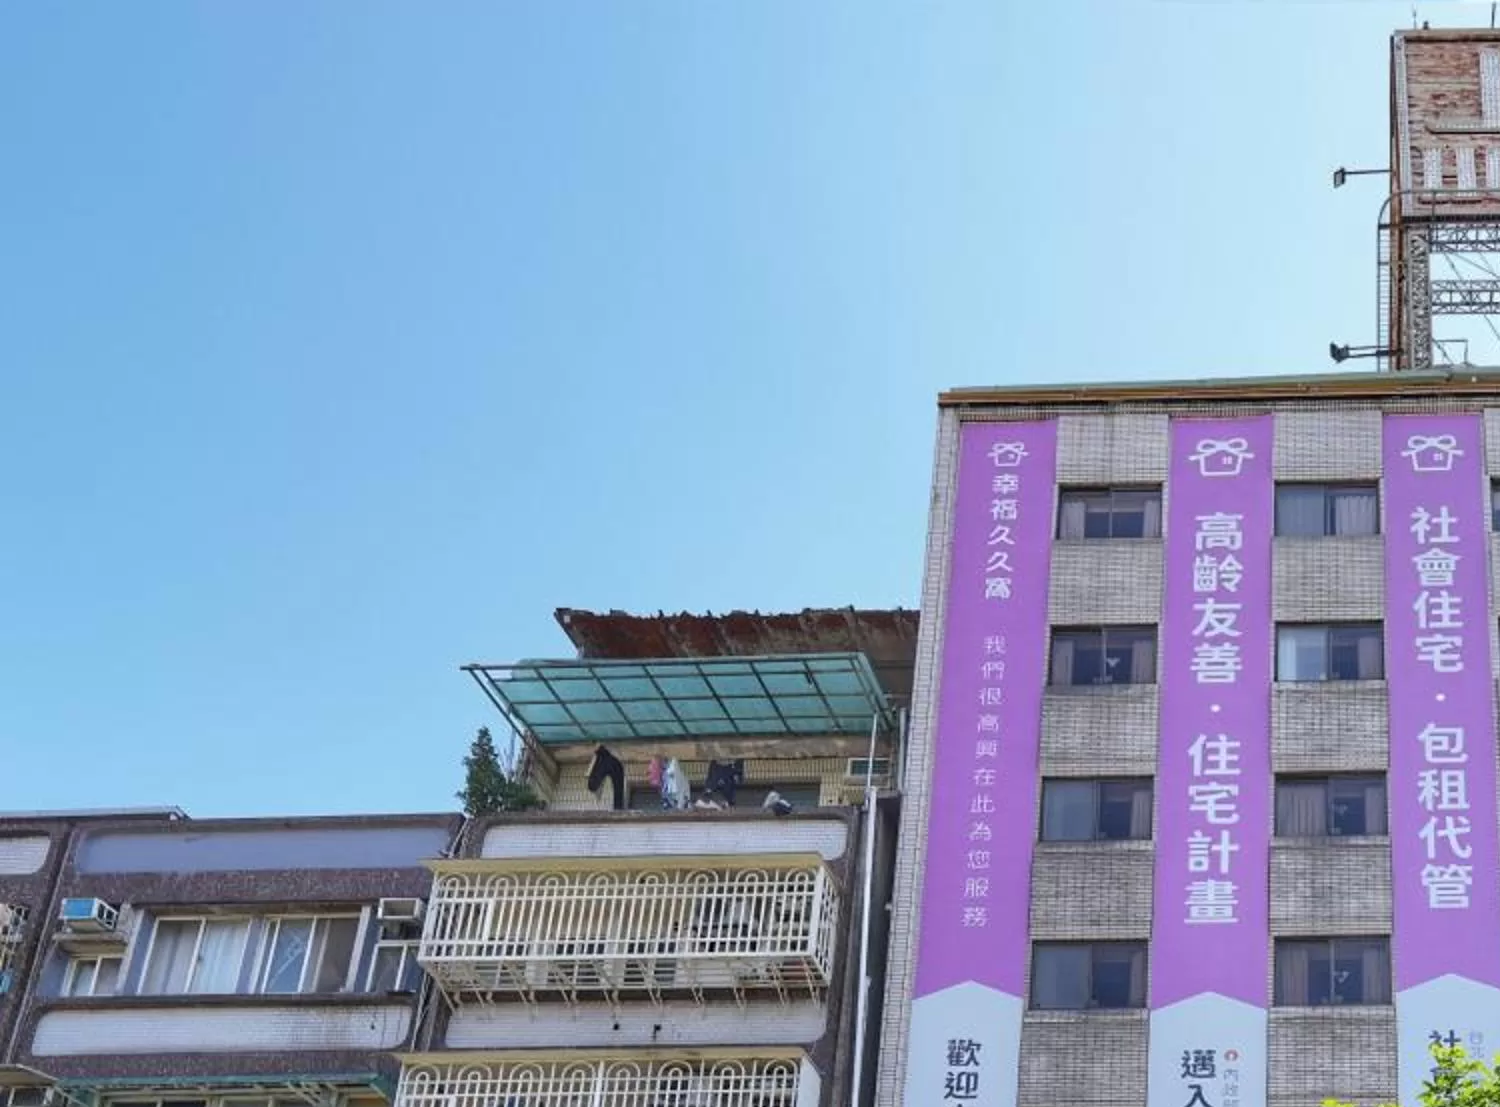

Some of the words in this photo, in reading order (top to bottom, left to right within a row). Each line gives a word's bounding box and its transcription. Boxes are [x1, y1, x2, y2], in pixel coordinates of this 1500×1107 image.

[984, 472, 1020, 600] 幸福久久窩
